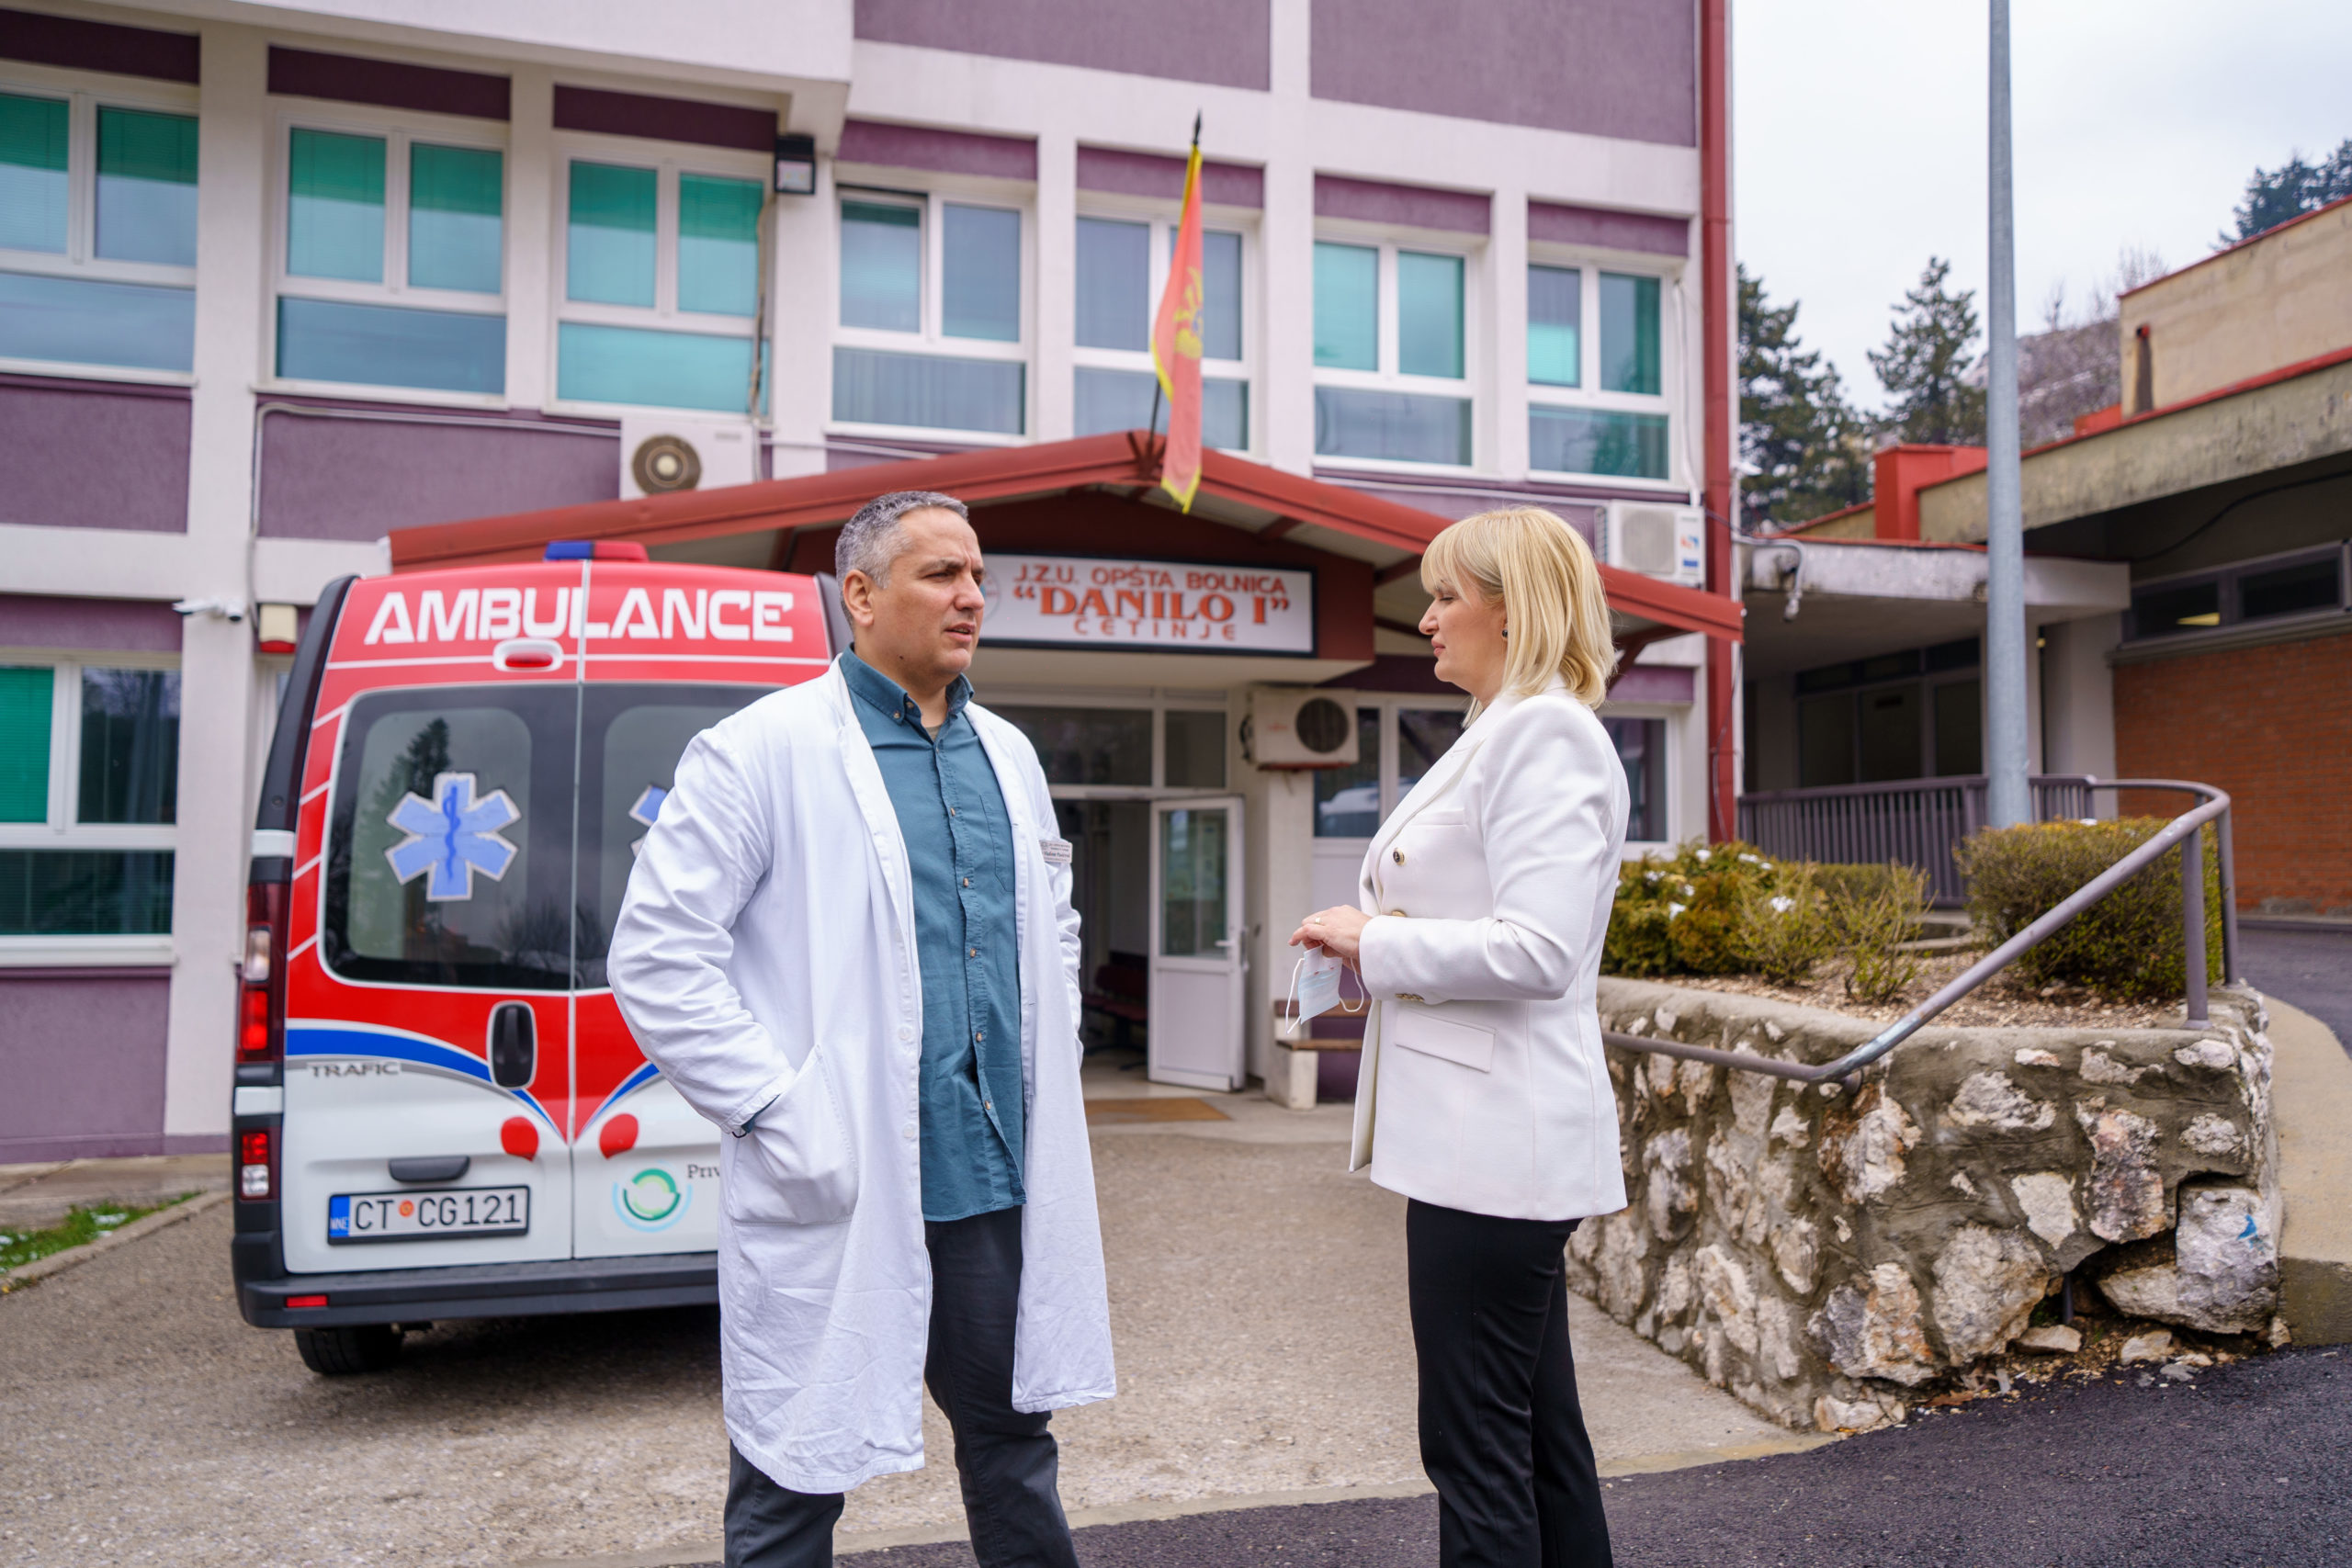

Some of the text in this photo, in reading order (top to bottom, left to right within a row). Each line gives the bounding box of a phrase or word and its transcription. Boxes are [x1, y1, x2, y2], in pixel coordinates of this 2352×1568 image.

[1013, 563, 1287, 594] J.Z.U. OPŠTA BOLNICA
[364, 587, 794, 645] AMBULANCE
[1073, 616, 1236, 641] CETINJE
[312, 1063, 400, 1078] TRAFIC
[355, 1199, 395, 1230] CT
